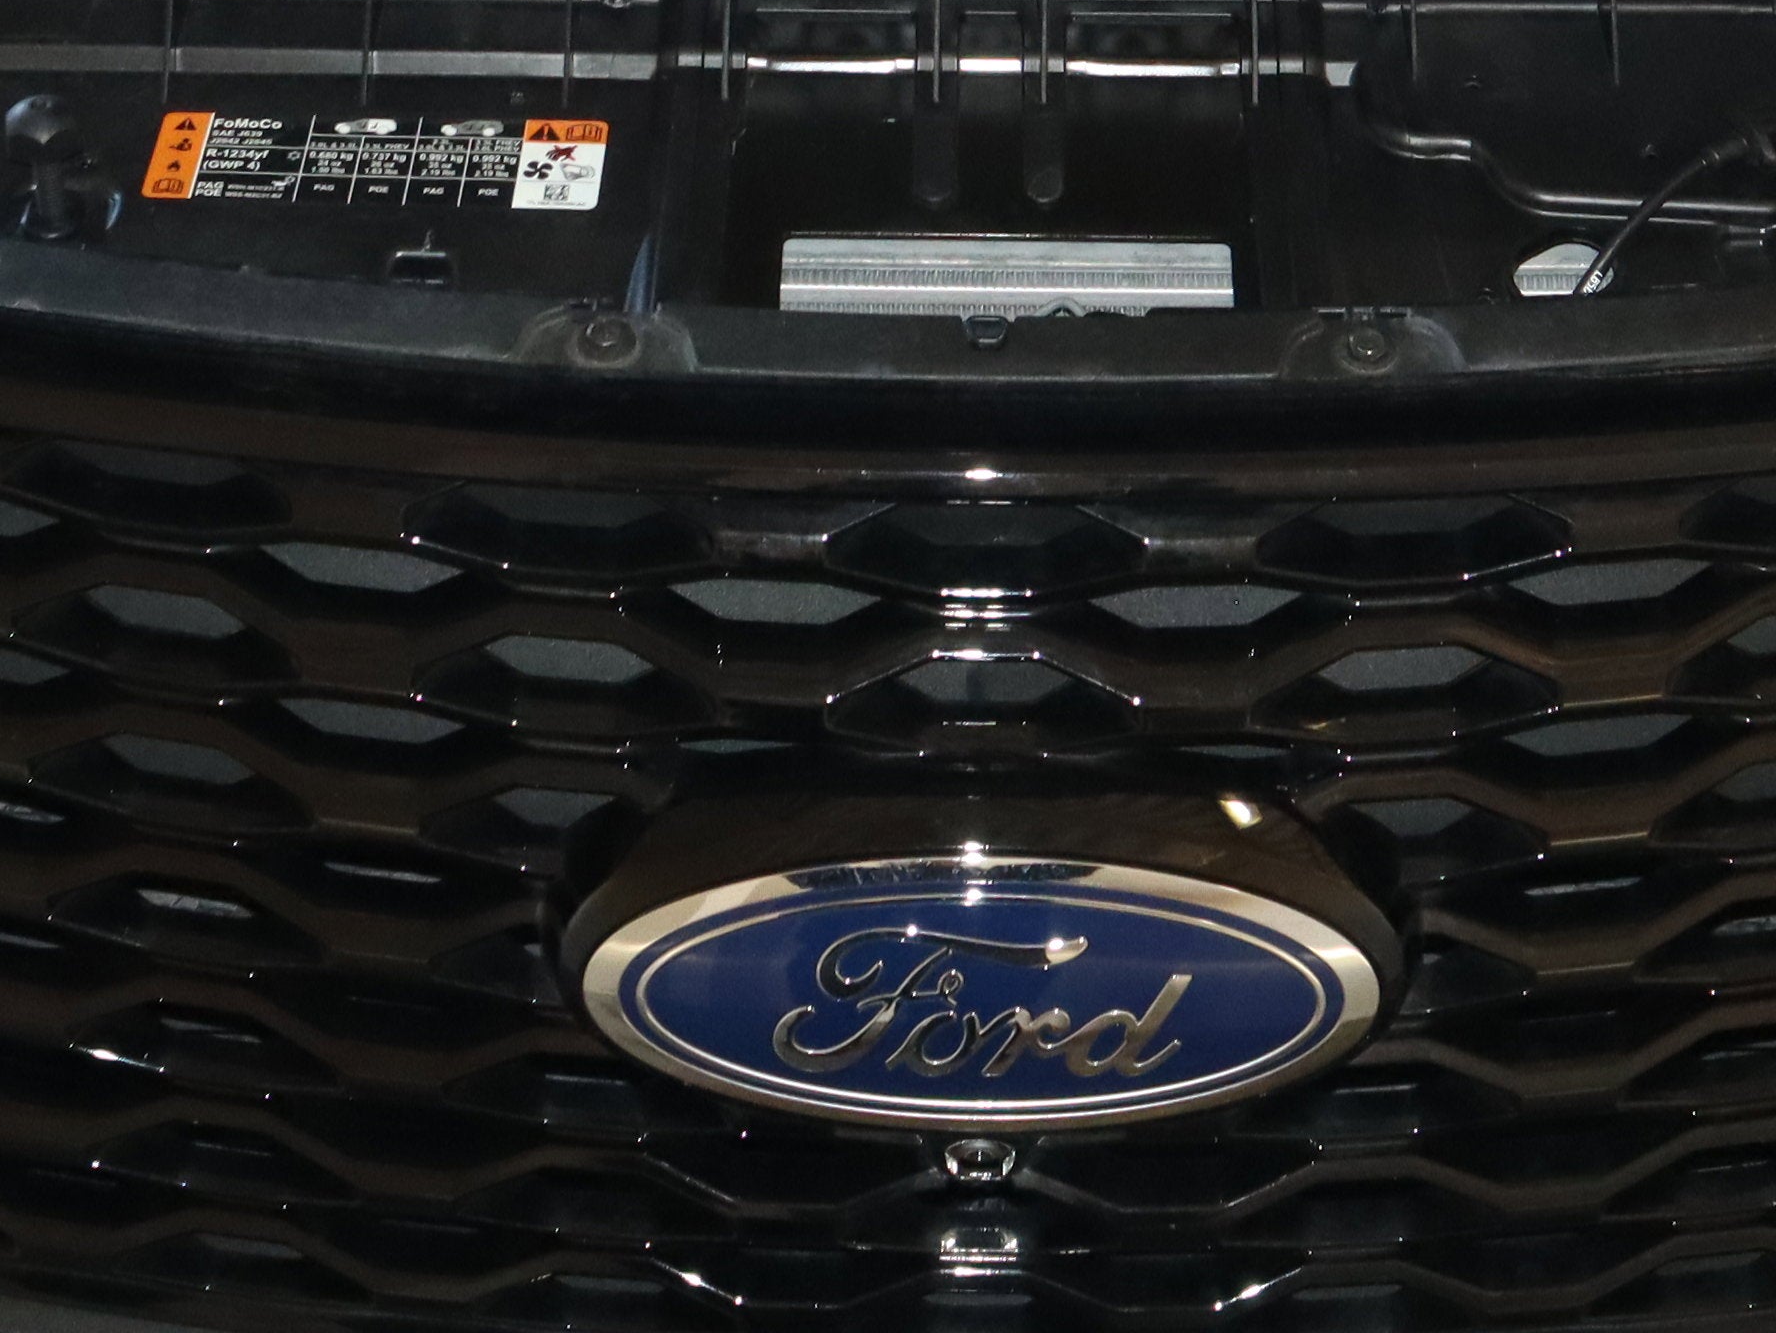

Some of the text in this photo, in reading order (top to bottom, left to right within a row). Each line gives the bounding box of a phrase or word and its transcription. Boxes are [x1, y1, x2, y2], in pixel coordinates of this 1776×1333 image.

[213, 118, 283, 130] FoMoCo
[211, 129, 264, 138] SAE J639
[205, 148, 270, 161] R-1234yf
[339, 152, 354, 162] kg
[392, 154, 407, 163] kg
[450, 154, 464, 164] kg
[503, 156, 518, 165] kg
[202, 159, 261, 172] (GWP 4)
[197, 181, 224, 189] PAG
[313, 183, 335, 191] PAG
[367, 185, 390, 194] POE
[194, 188, 223, 197] POE
[423, 187, 445, 195] PAG
[477, 188, 500, 197] POE
[771, 924, 1192, 1081] Ford
